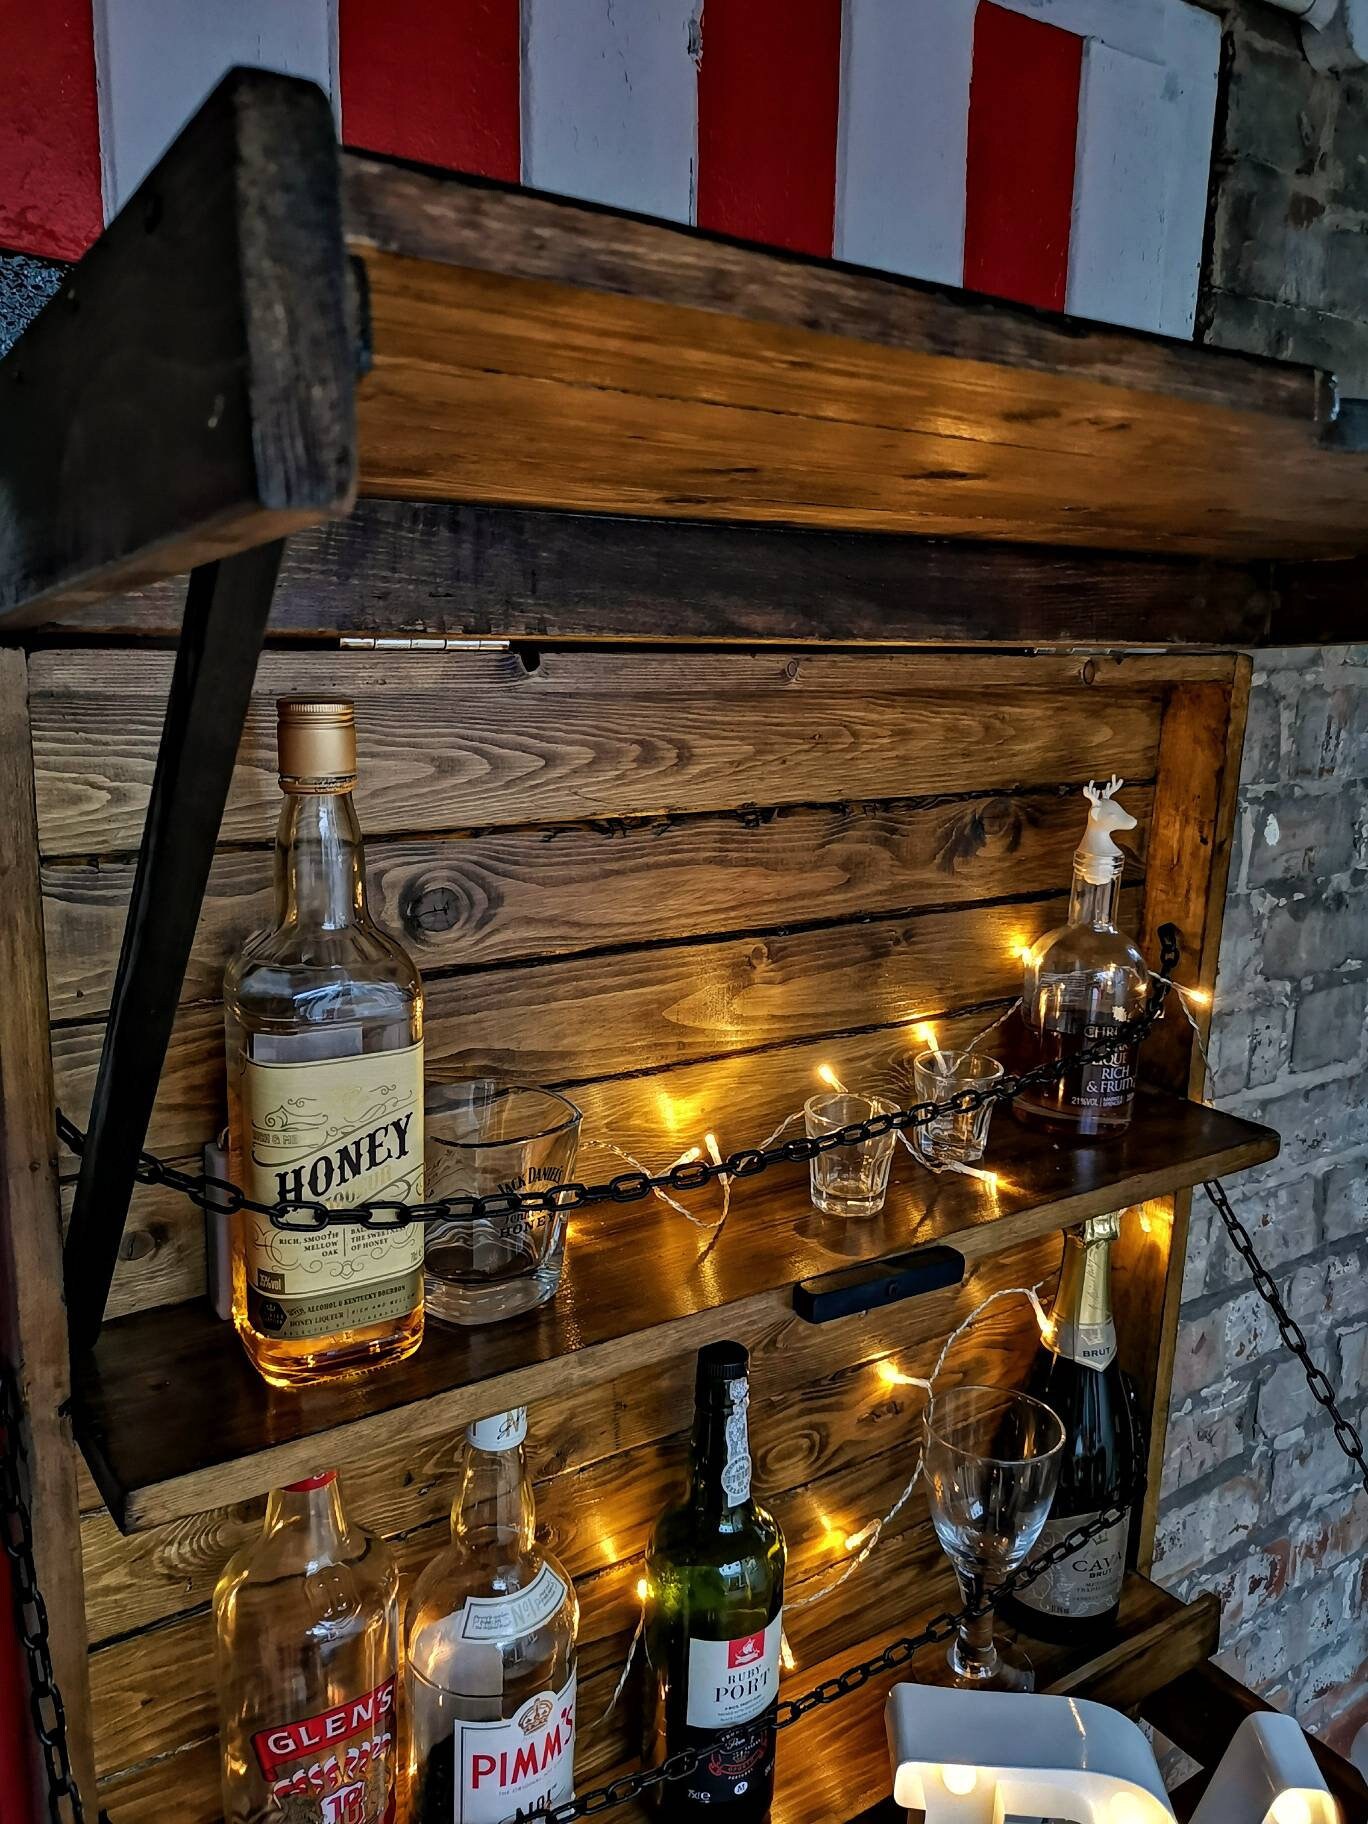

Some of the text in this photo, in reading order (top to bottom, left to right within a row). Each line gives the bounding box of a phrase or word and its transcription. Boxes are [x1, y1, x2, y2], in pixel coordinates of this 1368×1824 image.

[1102, 1065, 1129, 1079] RICH
[1086, 1080, 1098, 1092] &
[274, 1111, 413, 1212] HONEY
[497, 1175, 526, 1194] JACK
[303, 1231, 339, 1243] SMOOTH
[351, 1233, 366, 1243] THE
[304, 1241, 338, 1252] MELLOW
[351, 1238, 389, 1251] OF HONEY
[307, 1301, 337, 1312] ALCOHOL
[344, 1291, 378, 1305] KENTUCKY
[289, 1318, 313, 1327] HONEY
[315, 1312, 344, 1324] LIQUEUR
[1083, 1346, 1111, 1357] BRUT
[1089, 1568, 1112, 1578] BRUT
[728, 1664, 762, 1684] RUBY
[715, 1668, 770, 1702] PORT
[267, 1684, 393, 1754] GLEN'S
[471, 1703, 573, 1789] PIMM'S
